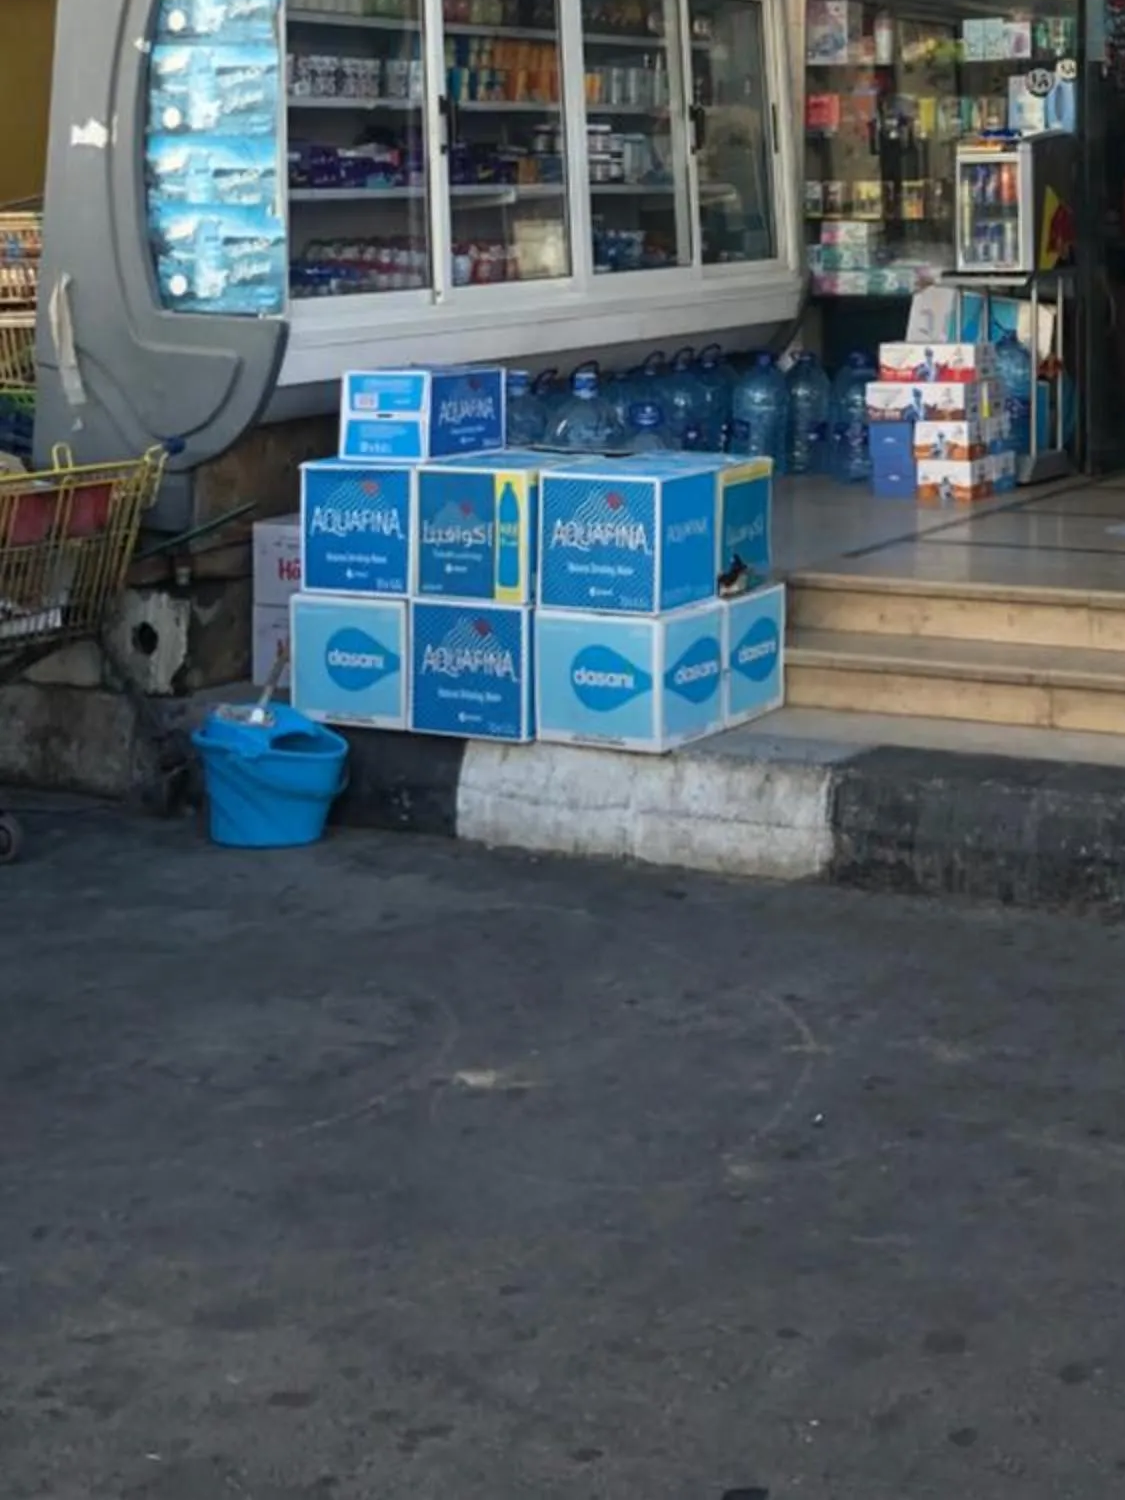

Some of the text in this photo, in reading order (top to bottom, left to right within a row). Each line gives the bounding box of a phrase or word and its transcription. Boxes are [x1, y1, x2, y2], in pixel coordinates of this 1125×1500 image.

[309, 506, 405, 540] AQUAFINA
[551, 519, 653, 556] AQUAFINA
[328, 649, 384, 669] dasani
[420, 643, 518, 683] AQUAFINA
[674, 659, 719, 685] dasani
[573, 667, 635, 690] dasani
